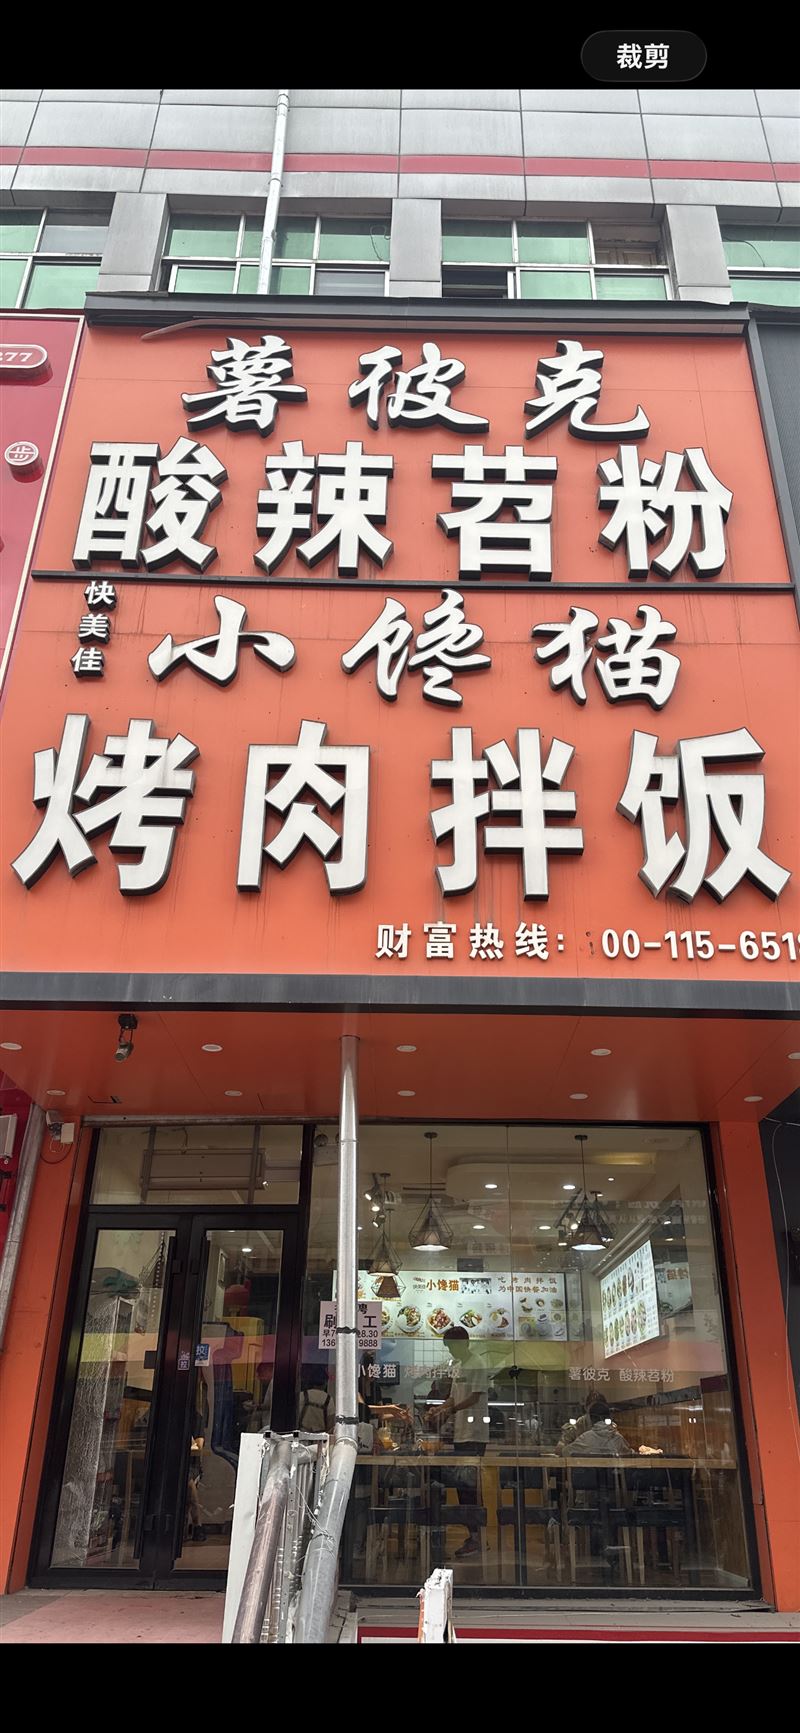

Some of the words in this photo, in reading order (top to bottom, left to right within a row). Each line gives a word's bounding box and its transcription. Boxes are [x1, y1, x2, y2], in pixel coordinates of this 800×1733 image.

[0, 351, 33, 362] 77
[182, 336, 649, 441] 薯彼克
[72, 436, 733, 579] 酸辣苕粉
[70, 580, 117, 679] 快美佳
[148, 589, 682, 710] 小馋猫
[11, 713, 792, 904] 烤肉拌饭
[601, 928, 800, 962] 00-115-651
[426, 1278, 460, 1292] 小馋猫
